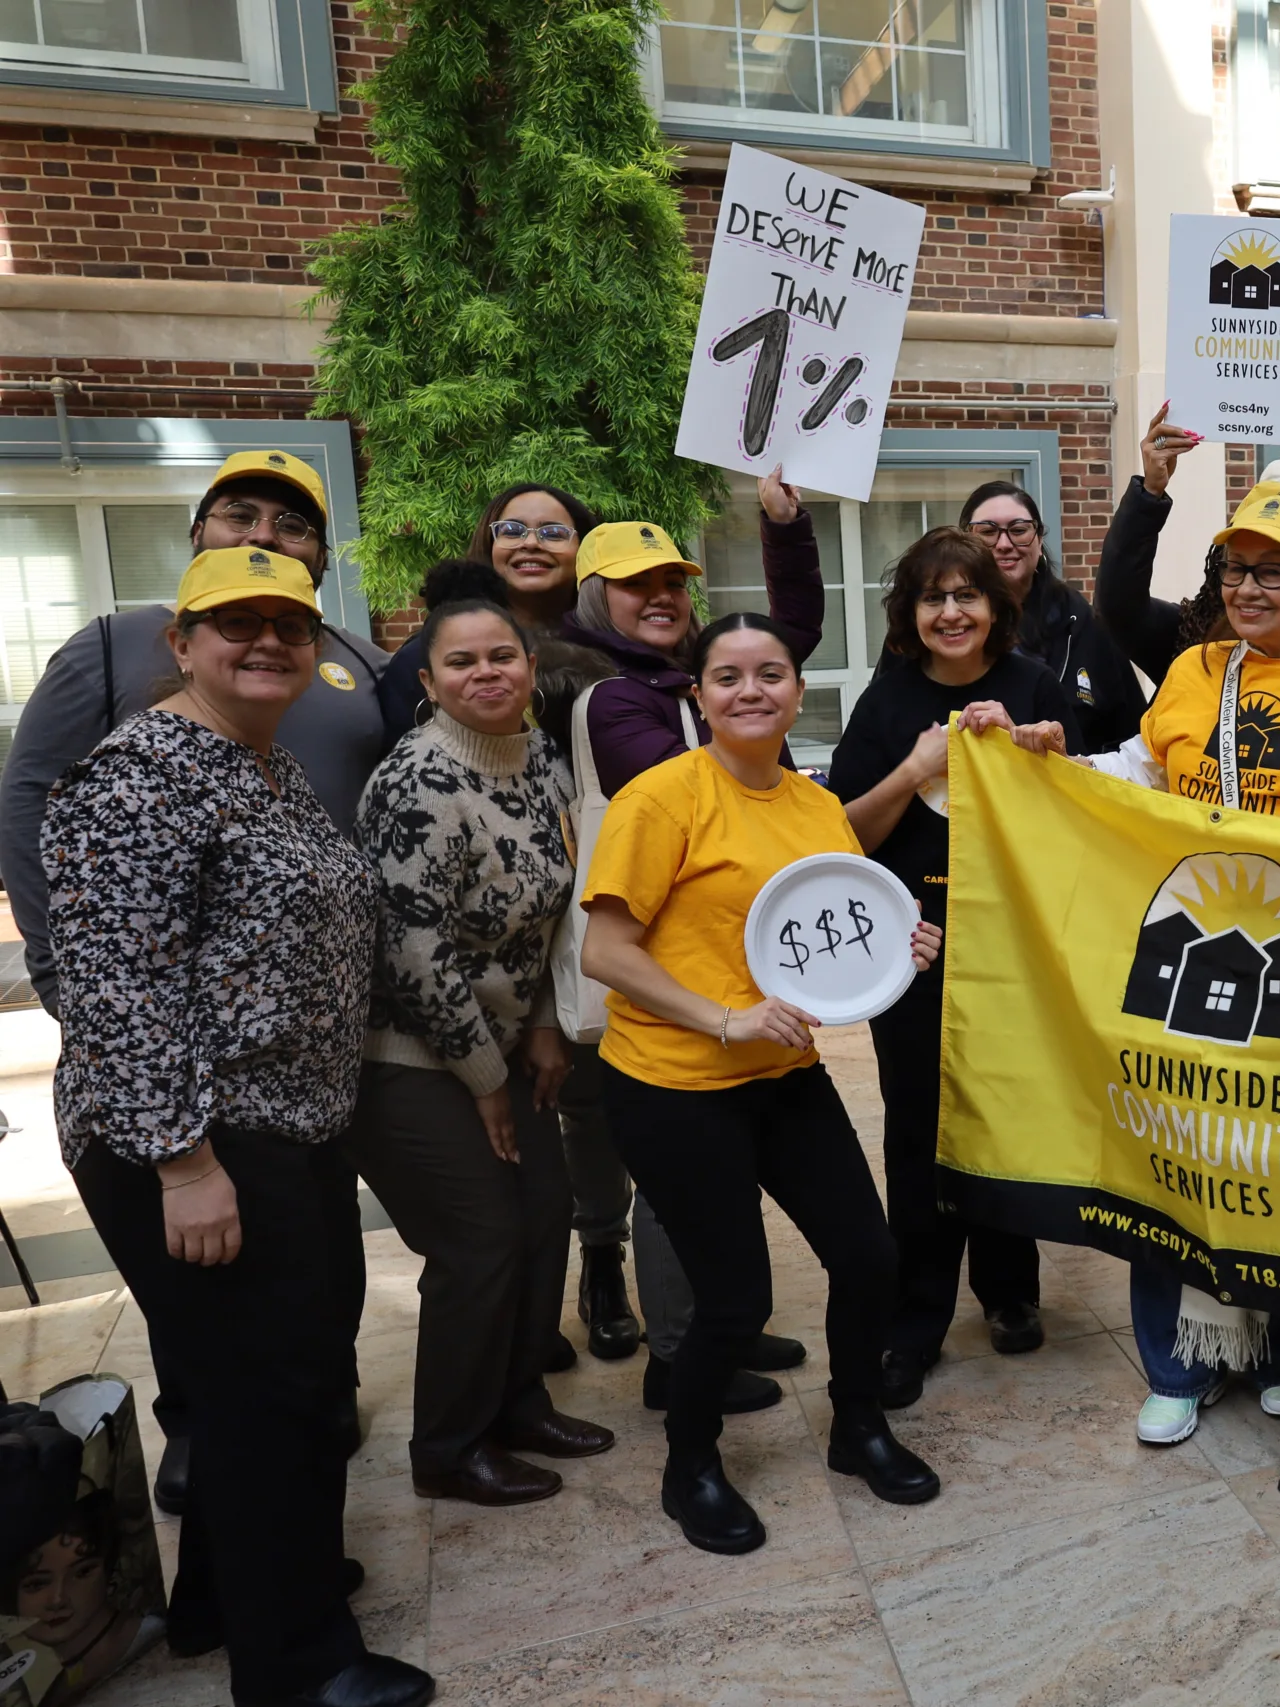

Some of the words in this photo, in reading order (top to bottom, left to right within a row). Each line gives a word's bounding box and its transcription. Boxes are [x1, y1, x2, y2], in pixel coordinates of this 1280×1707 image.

[785, 171, 860, 229] WE
[712, 308, 869, 457] 1%
[1216, 362, 1278, 380] SERVICES
[1218, 401, 1270, 416] @scs4ny
[1218, 422, 1274, 436] scsny.org
[1225, 668, 1236, 699] alvin
[1222, 699, 1235, 727] Klein
[1221, 730, 1233, 769] Calvin
[1196, 760, 1277, 792] SUYSIDE
[1223, 772, 1235, 803] Klein
[1150, 1153, 1274, 1218] SERVICES
